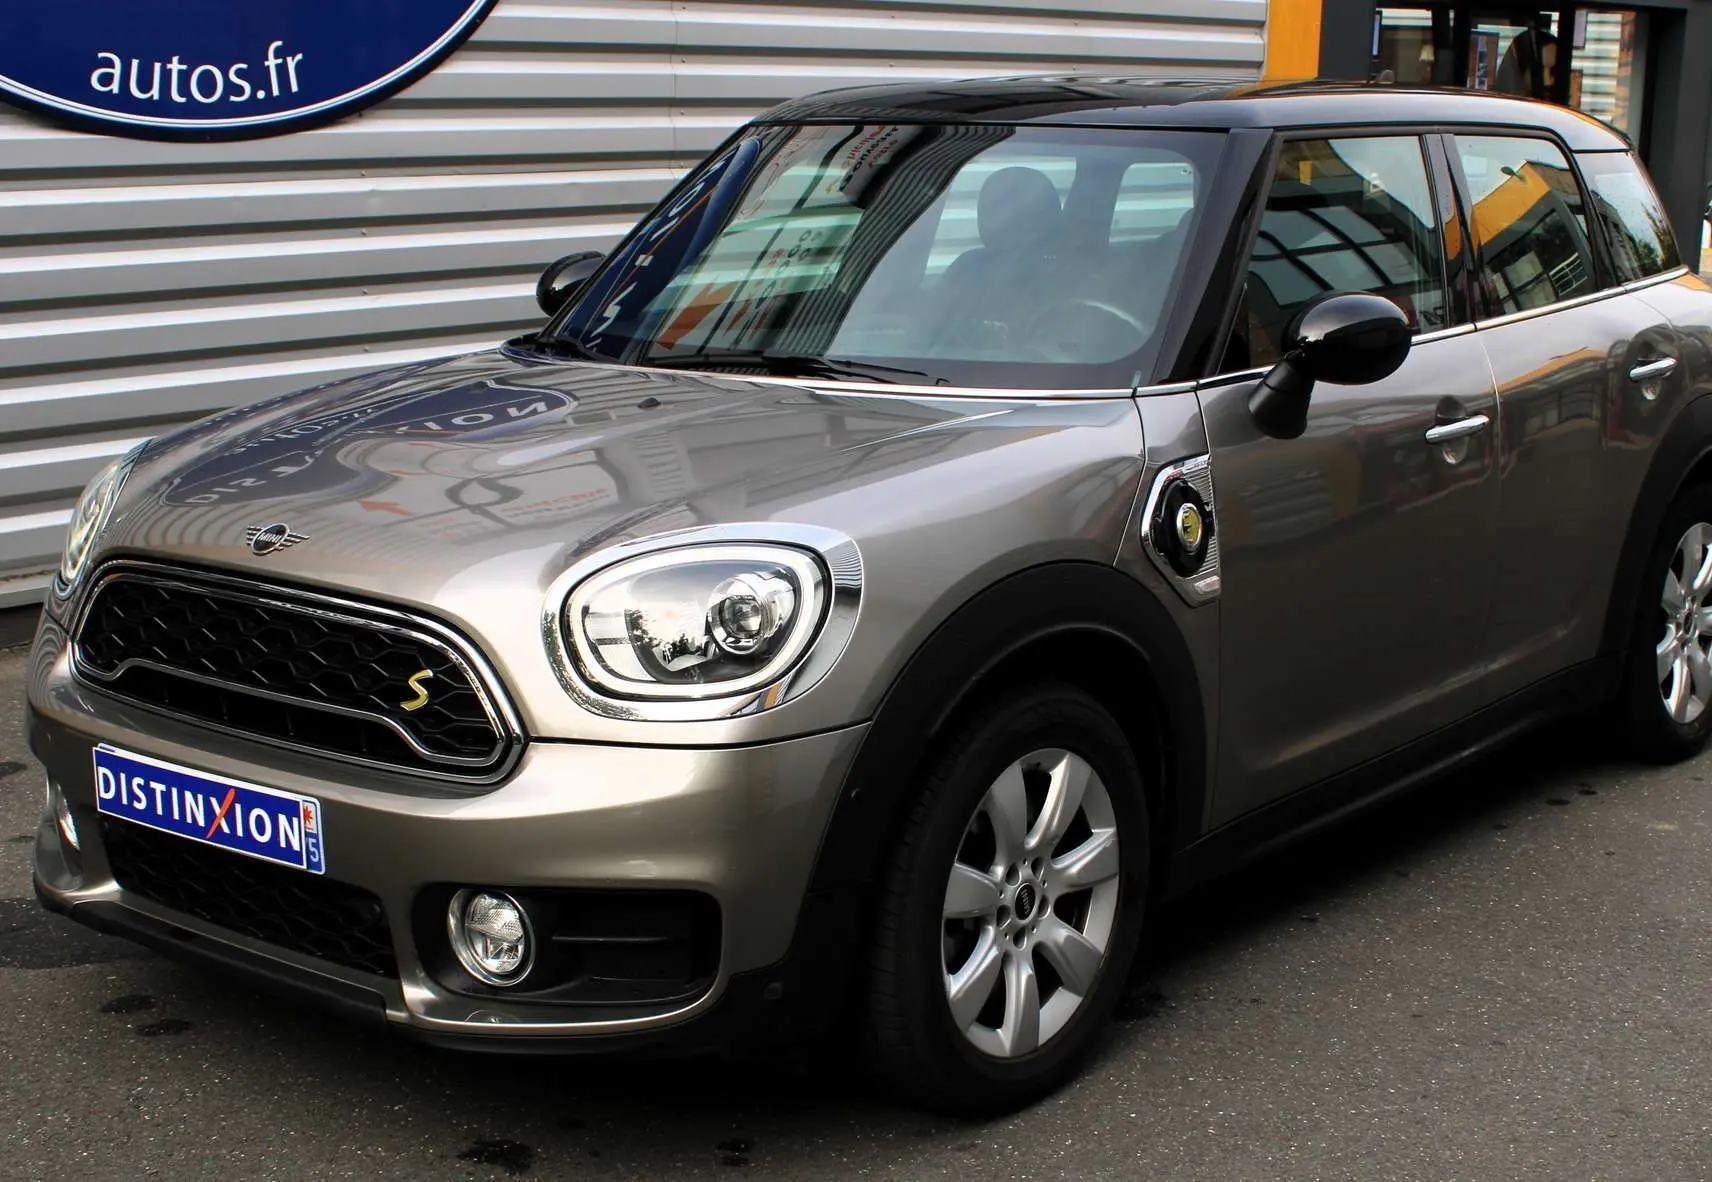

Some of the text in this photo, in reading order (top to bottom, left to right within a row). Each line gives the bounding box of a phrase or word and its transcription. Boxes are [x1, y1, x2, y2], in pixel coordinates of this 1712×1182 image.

[90, 40, 303, 102] autos.fr
[400, 669, 433, 711] S
[97, 766, 302, 851] DISTINXION
[306, 837, 319, 863] 5
